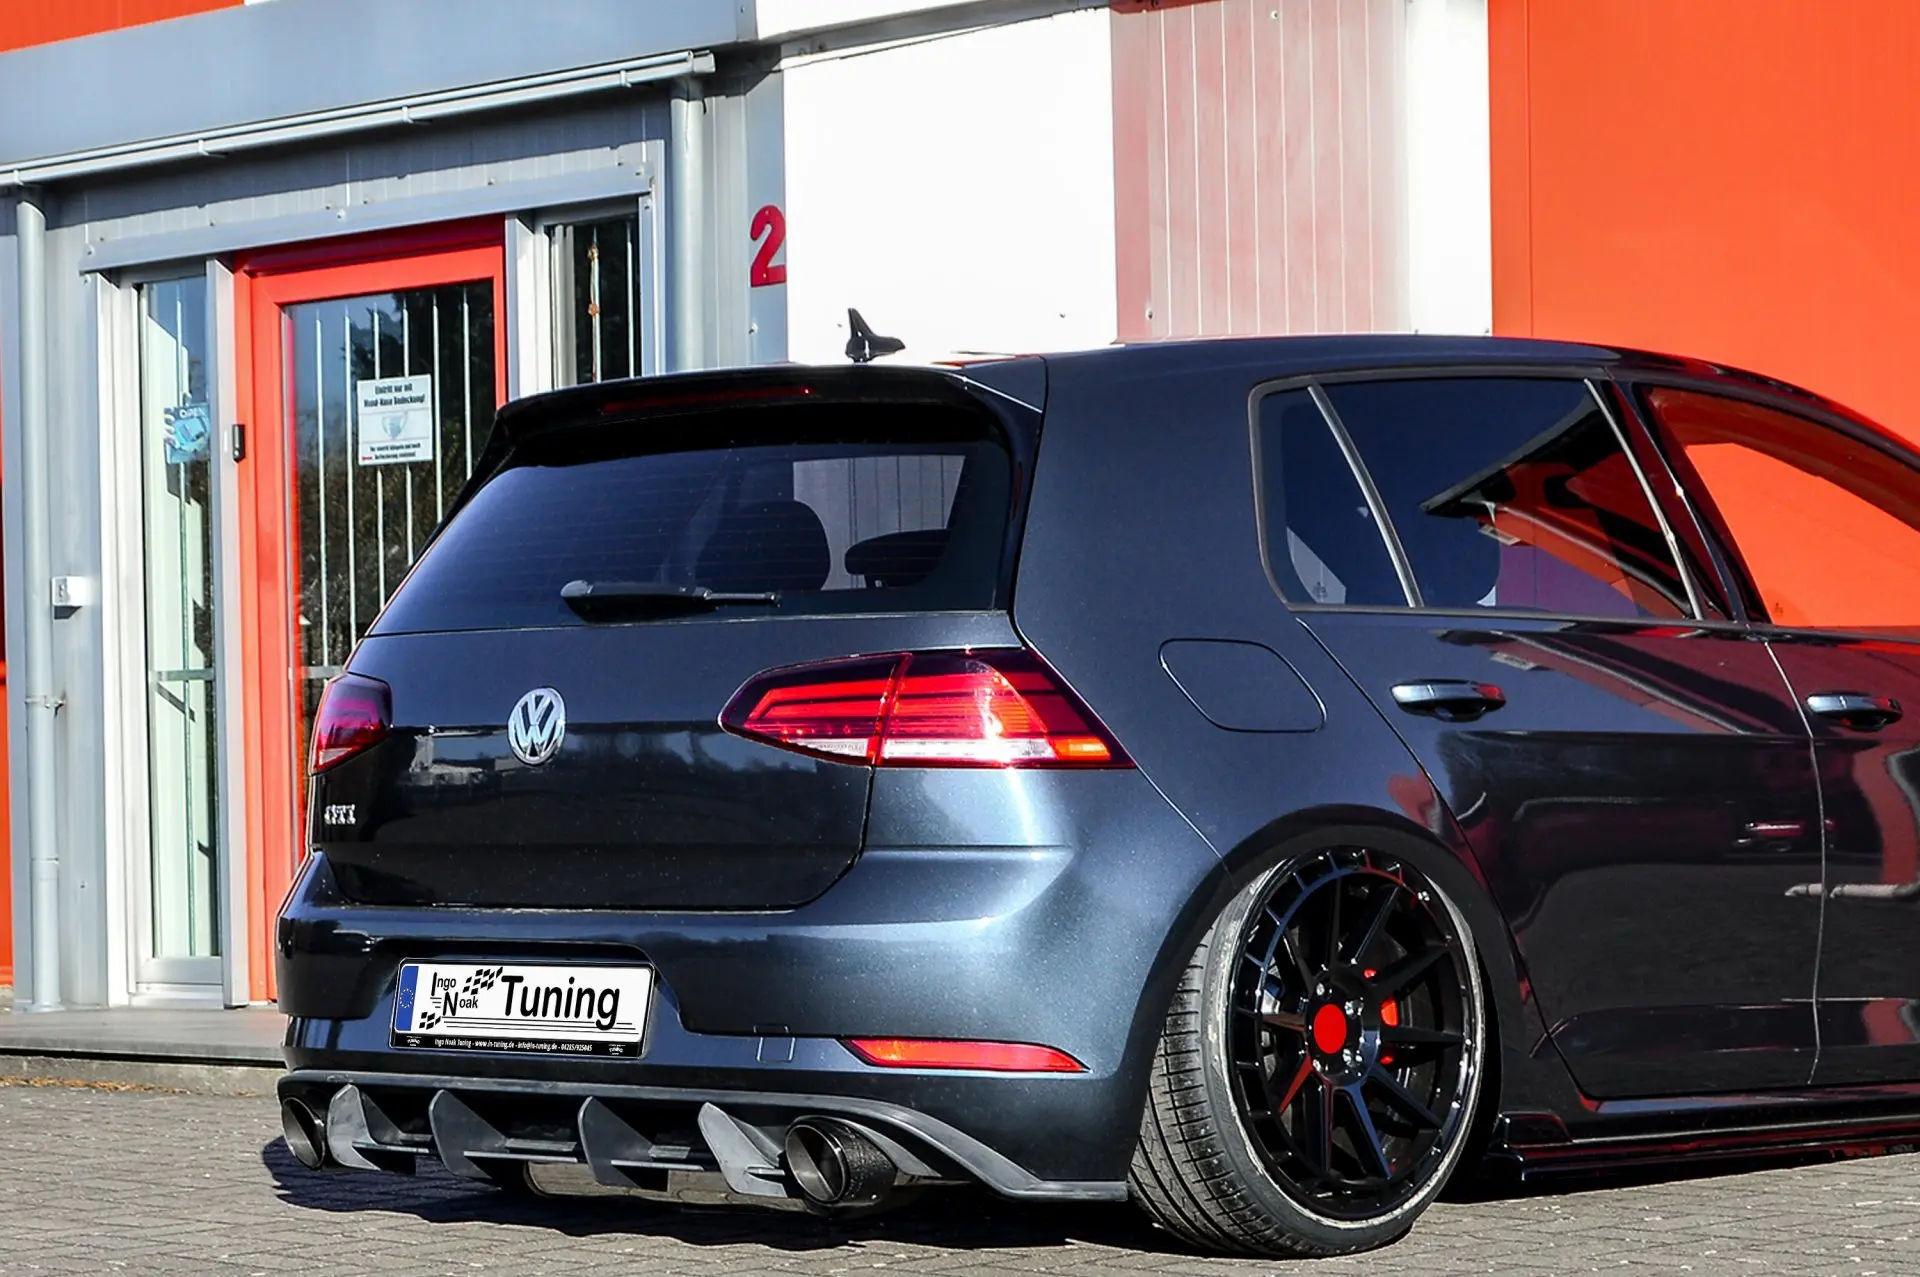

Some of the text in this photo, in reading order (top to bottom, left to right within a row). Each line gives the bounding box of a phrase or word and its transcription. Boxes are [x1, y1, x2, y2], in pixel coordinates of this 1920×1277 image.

[750, 204, 786, 288] 2
[324, 803, 356, 825] GTI
[431, 971, 457, 997] Ingo
[442, 991, 479, 1017] Noak
[500, 974, 620, 1031] Tuning
